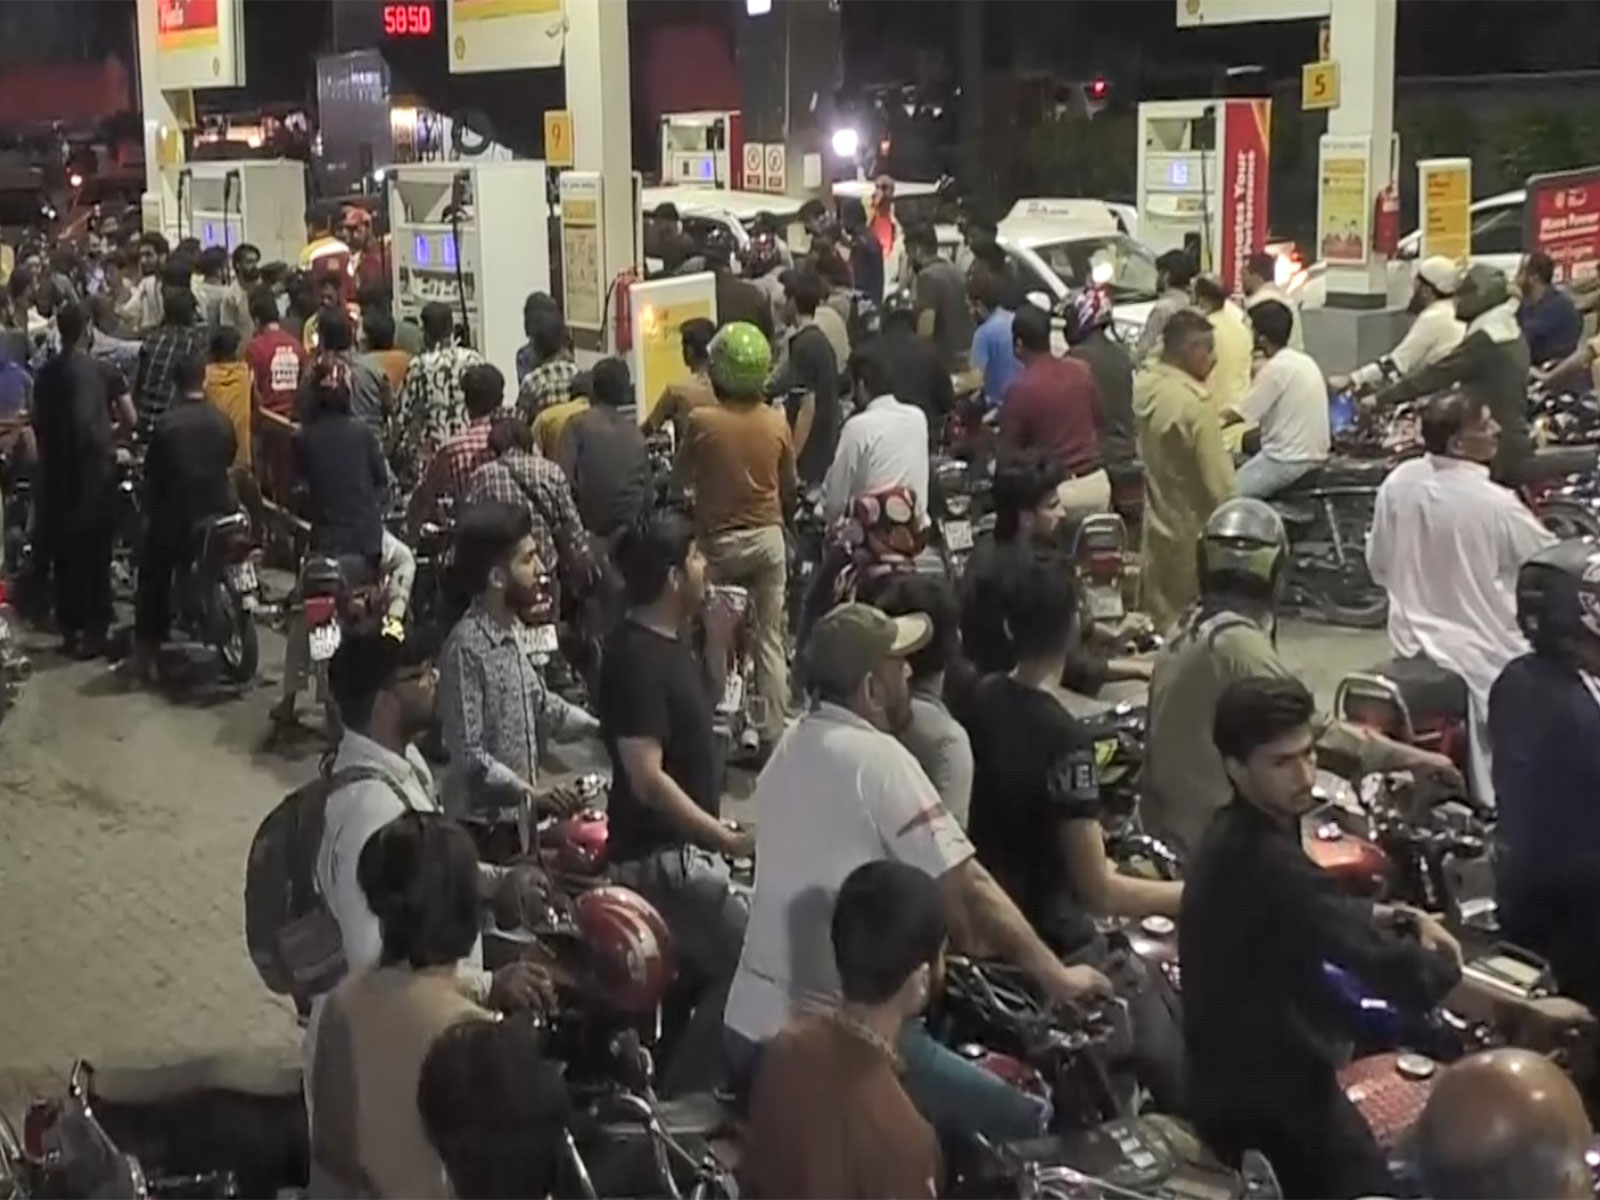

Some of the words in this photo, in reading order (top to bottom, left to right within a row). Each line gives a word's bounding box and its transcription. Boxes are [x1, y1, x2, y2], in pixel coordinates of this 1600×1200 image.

[1313, 73, 1326, 98] 5
[551, 122, 562, 151] 9
[1234, 150, 1246, 198] Your
